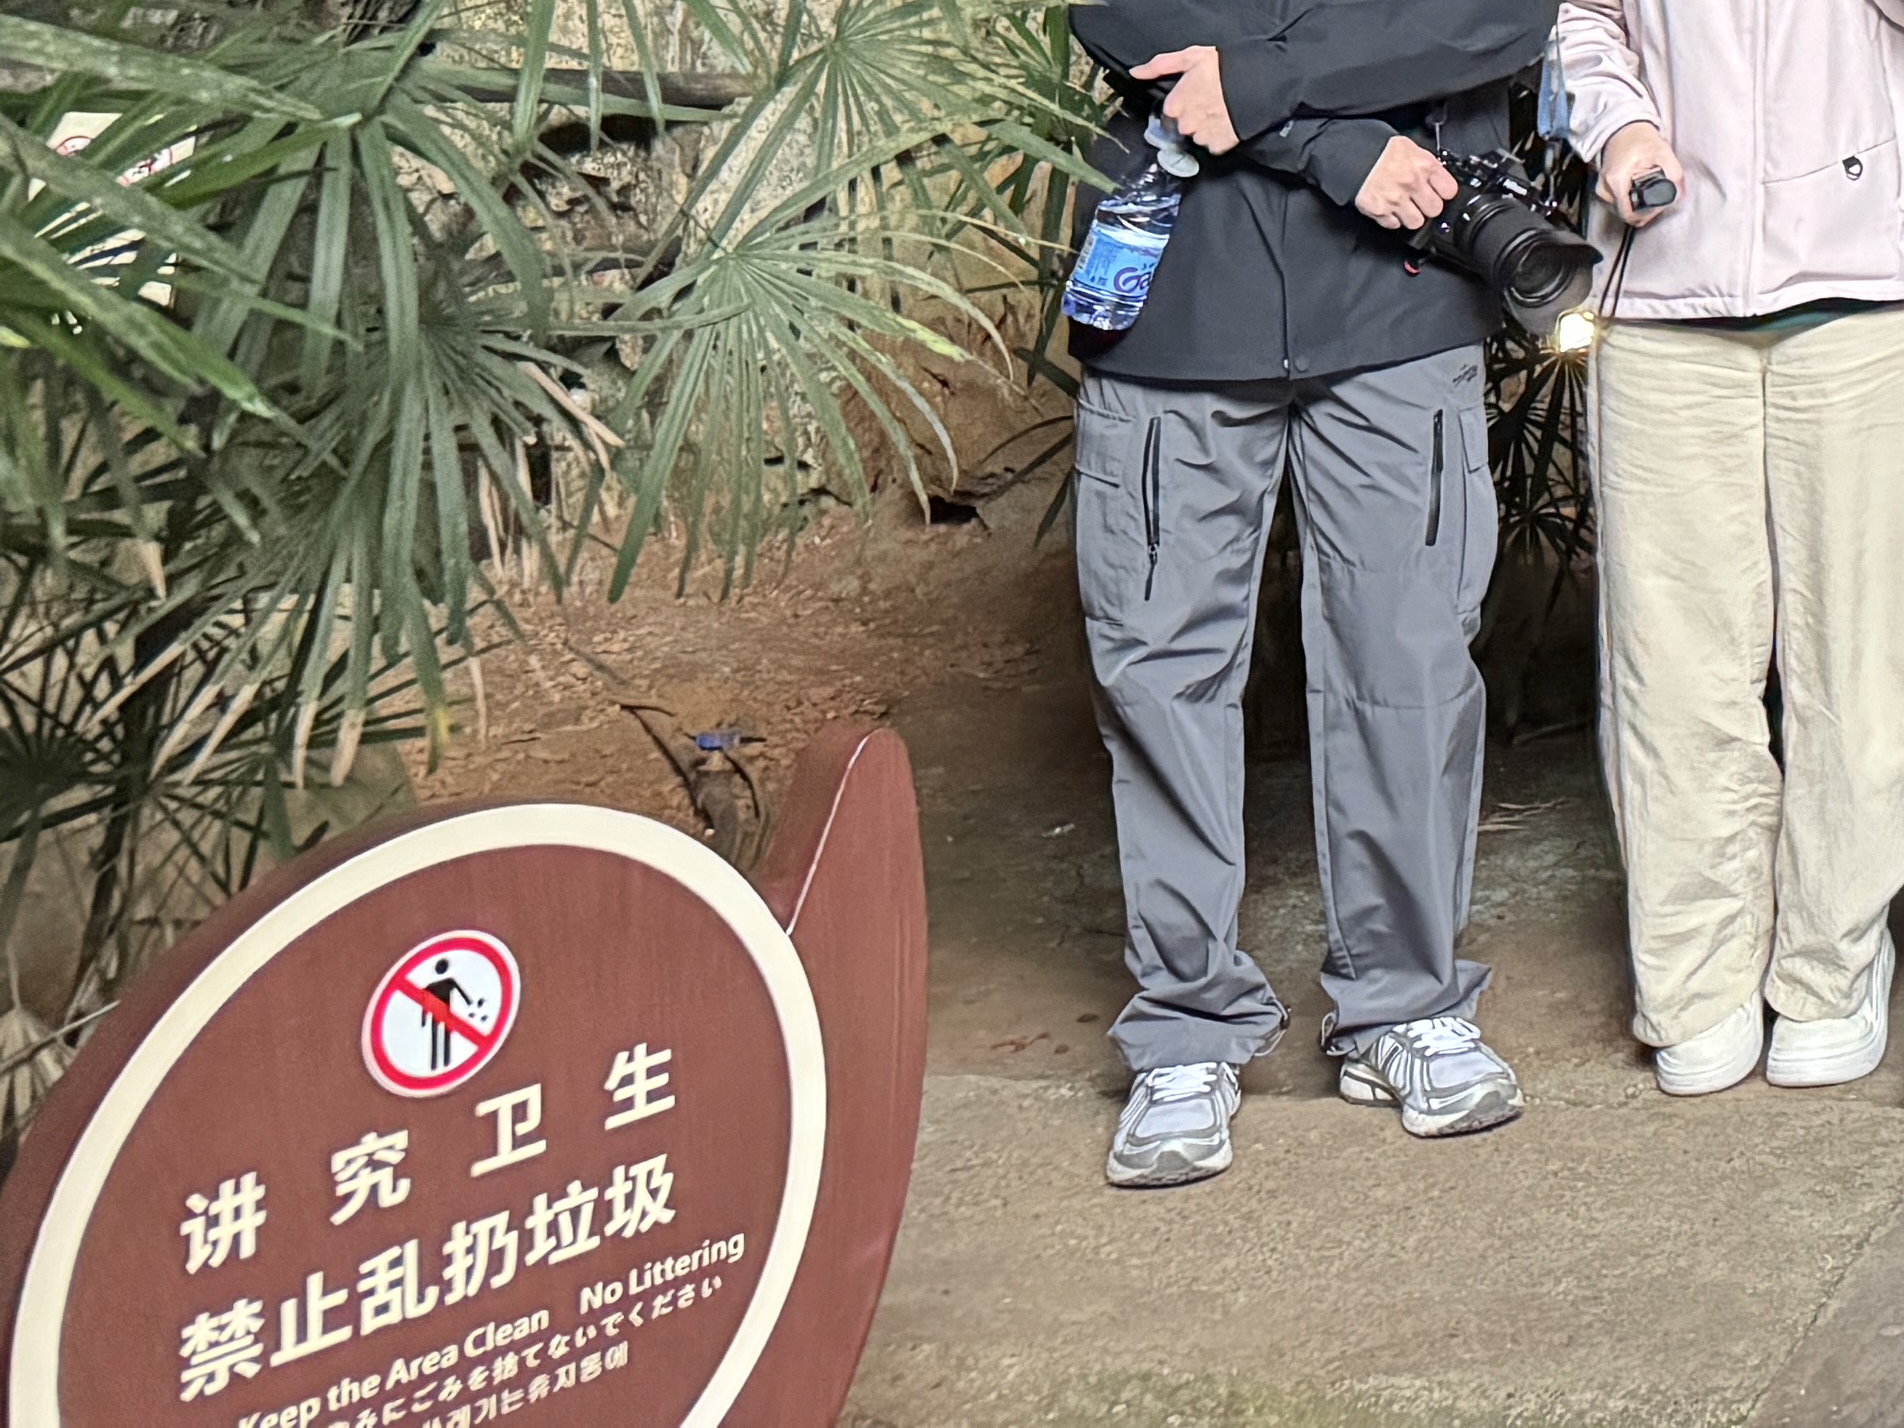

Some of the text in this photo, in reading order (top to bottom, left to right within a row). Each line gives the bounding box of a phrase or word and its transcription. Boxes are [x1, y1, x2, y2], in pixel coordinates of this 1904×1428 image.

[179, 1042, 677, 1275] 讲究卫生
[178, 1152, 677, 1403] 禁止乱扔垃圾
[326, 1377, 382, 1412] the
[385, 1344, 459, 1392] Area
[463, 1309, 550, 1358] Clean
[580, 1281, 624, 1315] No
[628, 1233, 745, 1296] Littering
